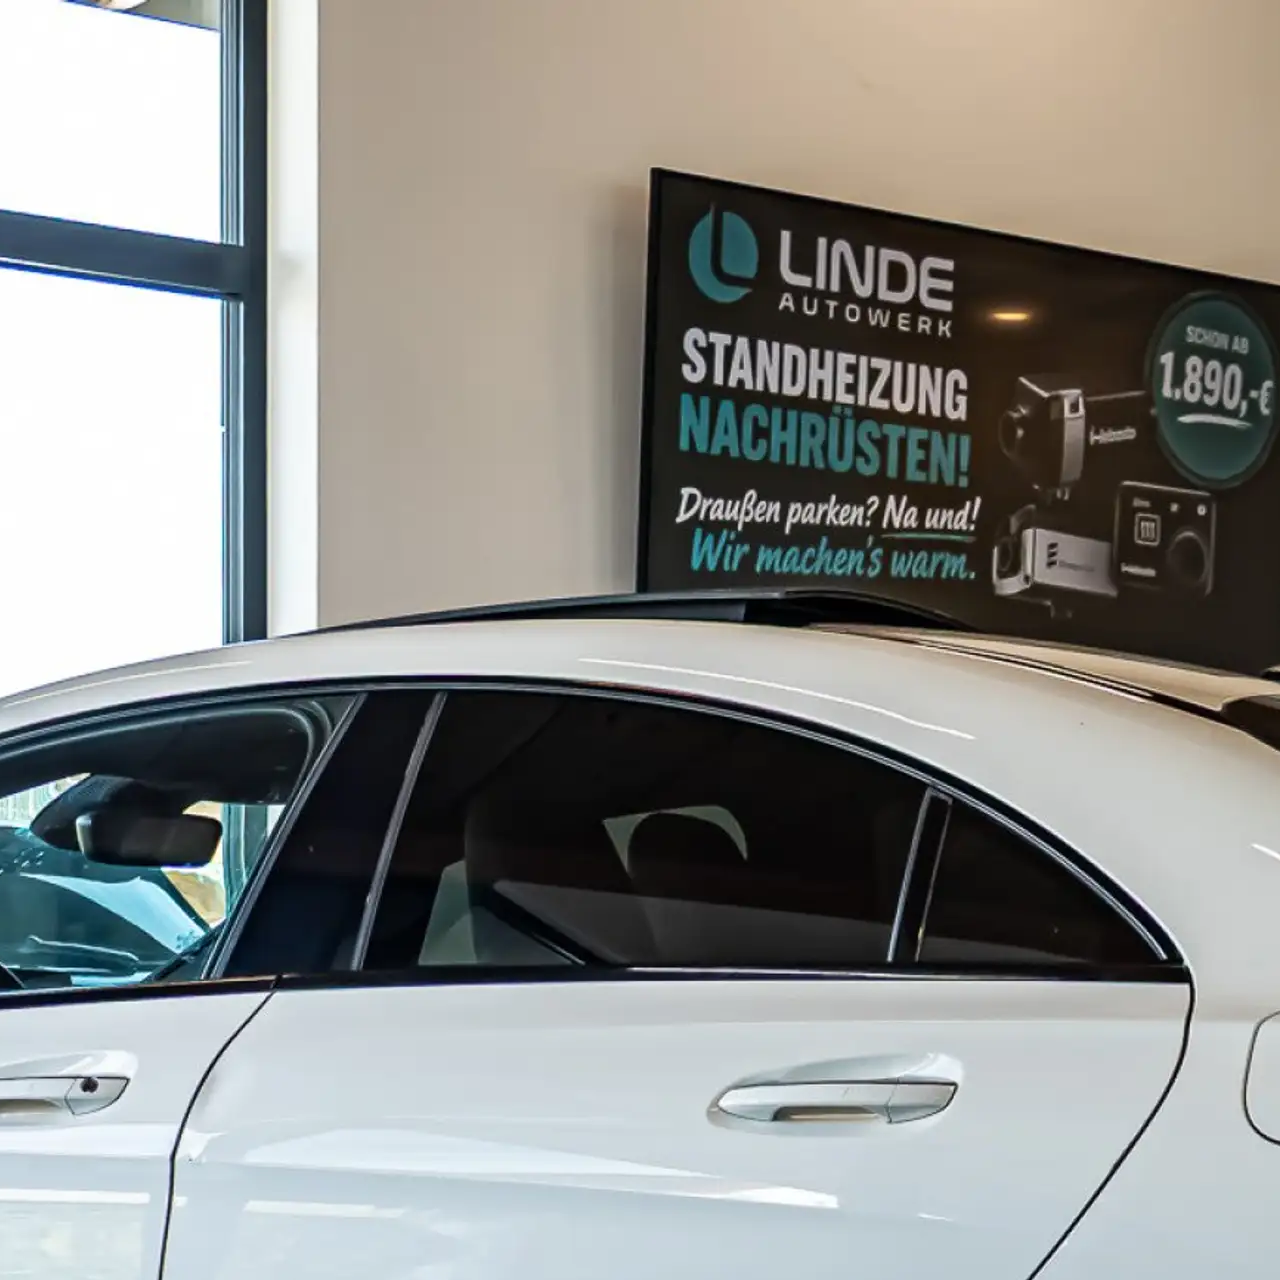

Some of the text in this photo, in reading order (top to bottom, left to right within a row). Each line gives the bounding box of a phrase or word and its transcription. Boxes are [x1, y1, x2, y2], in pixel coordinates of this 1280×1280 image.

[779, 229, 955, 312] LINDE
[778, 292, 953, 338] AUTOWERK
[1184, 325, 1250, 355] SCHON AB
[681, 327, 969, 421] STANDHEIZUNG
[679, 392, 972, 488] NACHRÜSTEN!
[675, 487, 982, 535] Draußen parken? Na und!
[690, 527, 977, 580] Wir machen's warm.
